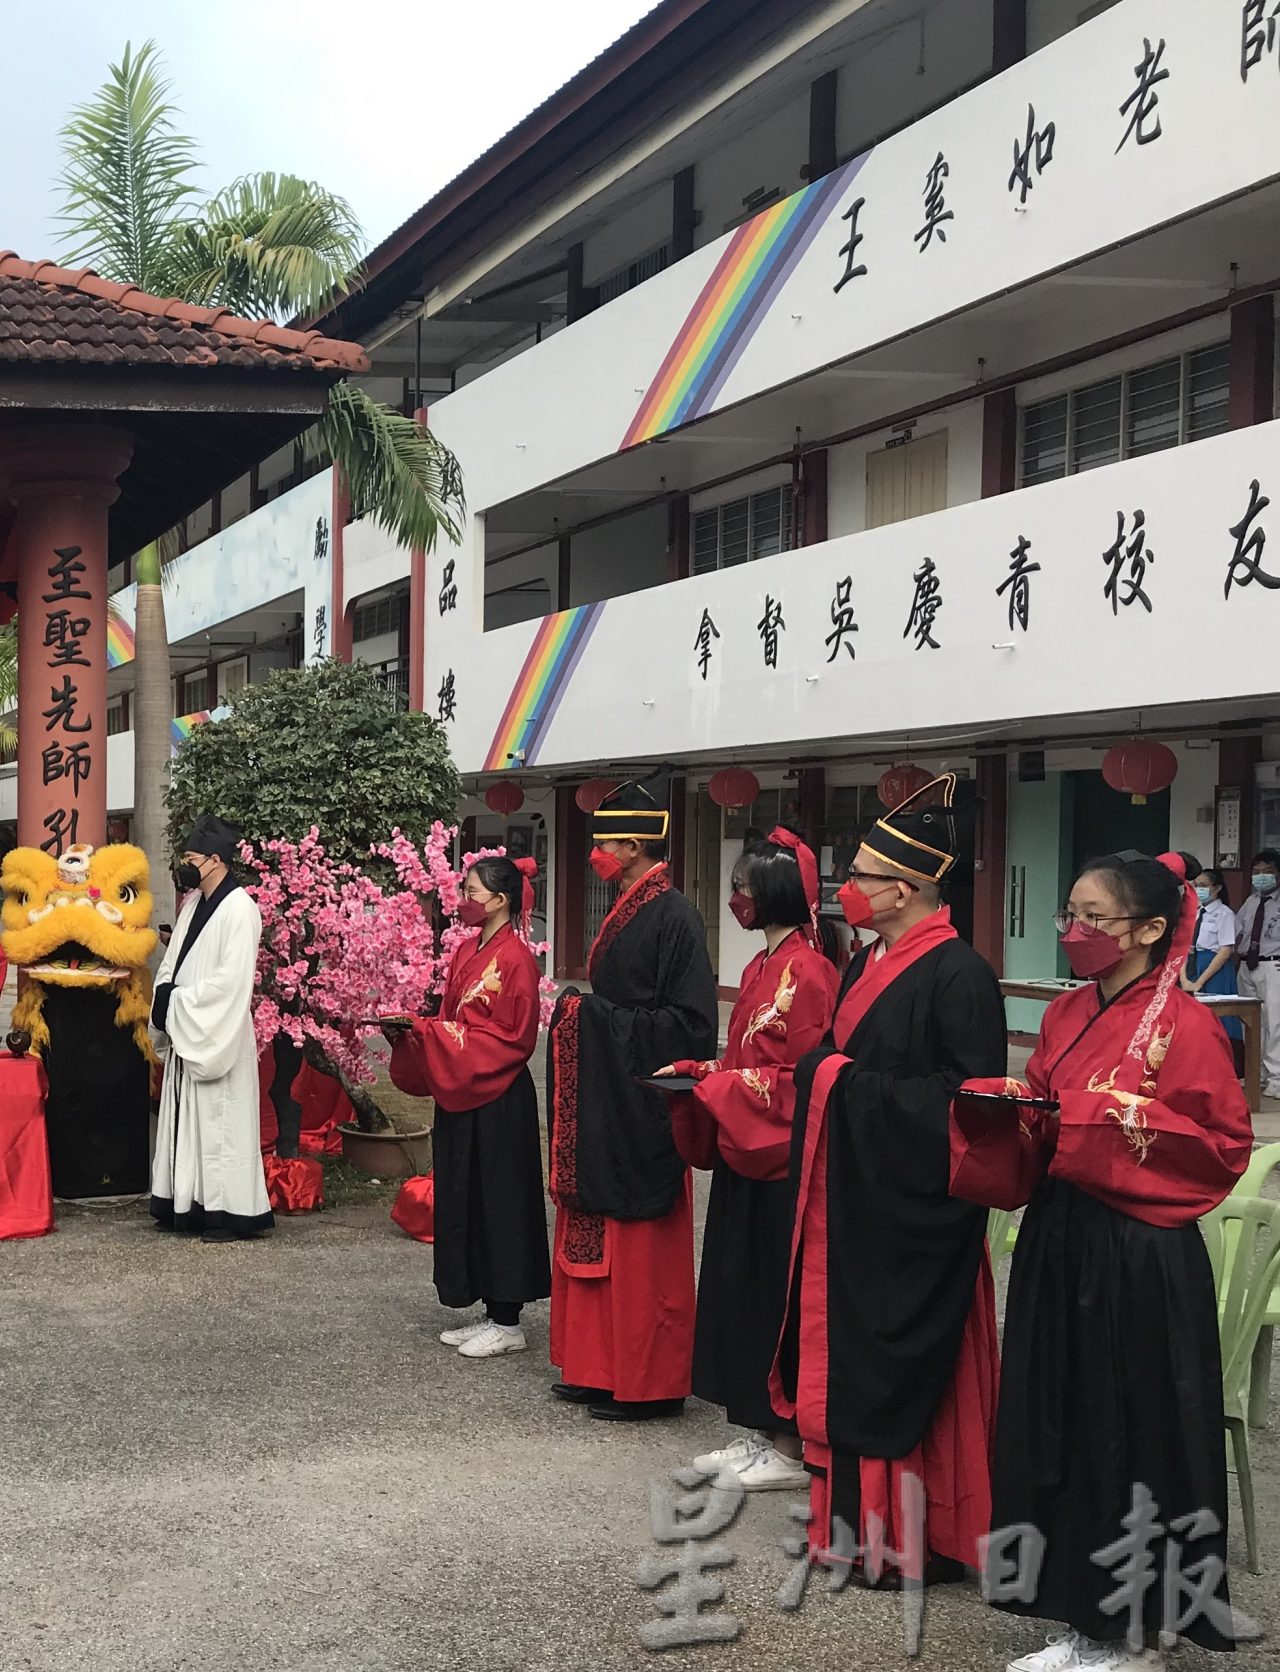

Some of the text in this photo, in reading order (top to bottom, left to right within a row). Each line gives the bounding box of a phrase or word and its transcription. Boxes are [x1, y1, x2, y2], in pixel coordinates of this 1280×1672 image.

[41, 545, 92, 860] 至聖先師孔
[694, 478, 1280, 680] 拿督吳慶青校友
